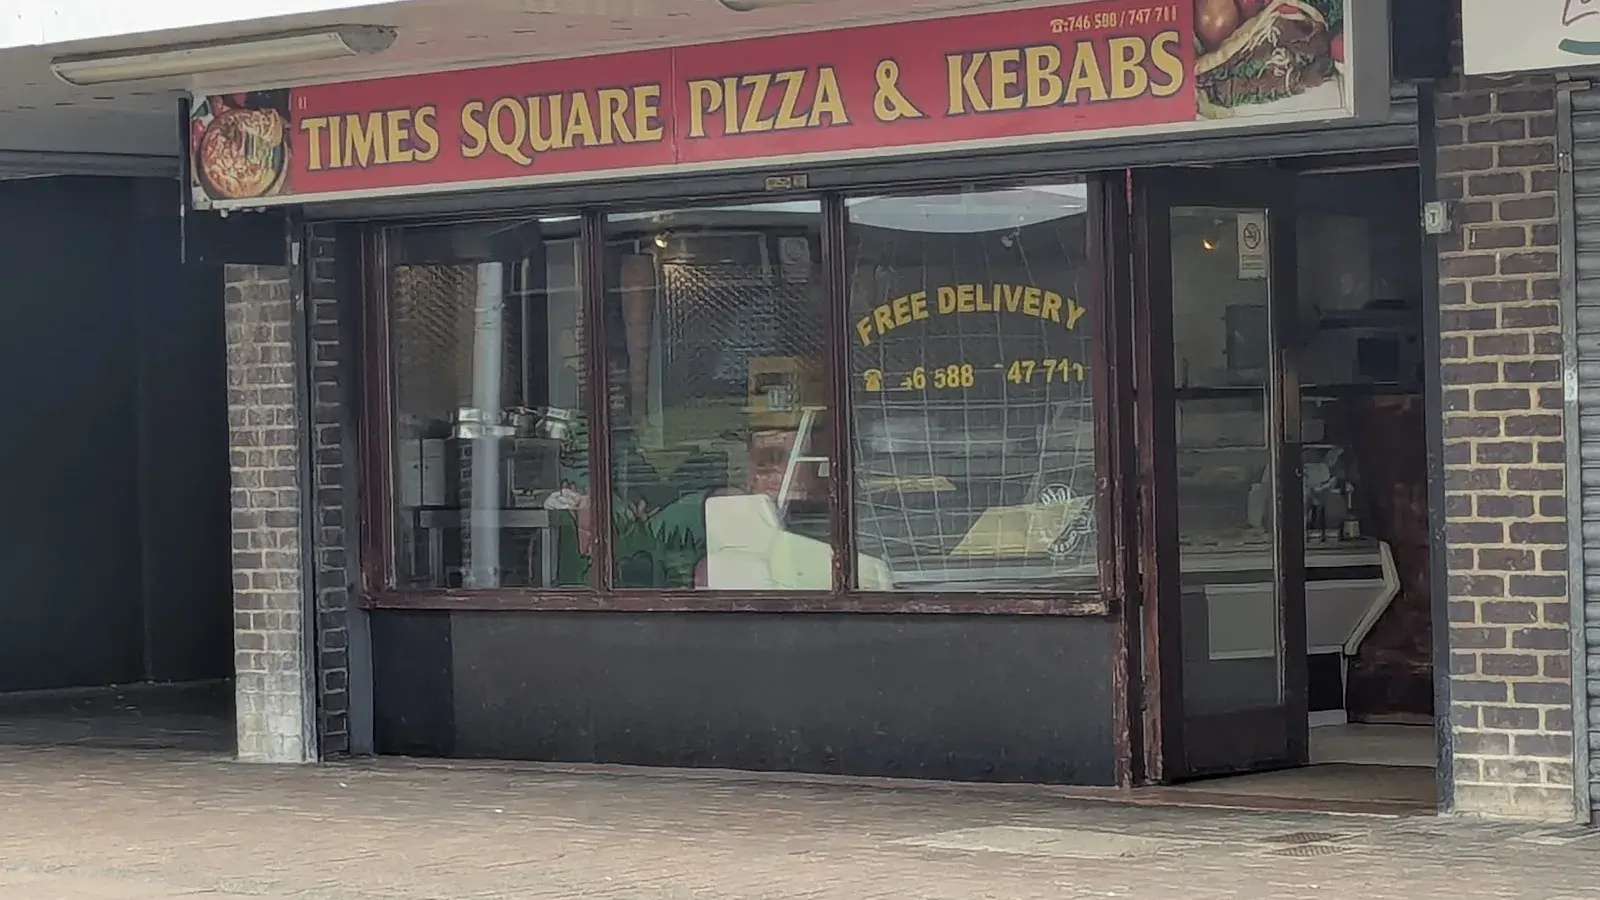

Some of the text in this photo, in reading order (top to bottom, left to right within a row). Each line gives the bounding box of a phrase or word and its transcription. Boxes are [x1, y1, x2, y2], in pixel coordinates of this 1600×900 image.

[1128, 7, 1152, 25] 747
[301, 31, 1185, 171] TIMES SQUARE PIZZA & KEBABS
[855, 284, 1086, 347] FREE DELIVERY
[933, 363, 975, 390] 588
